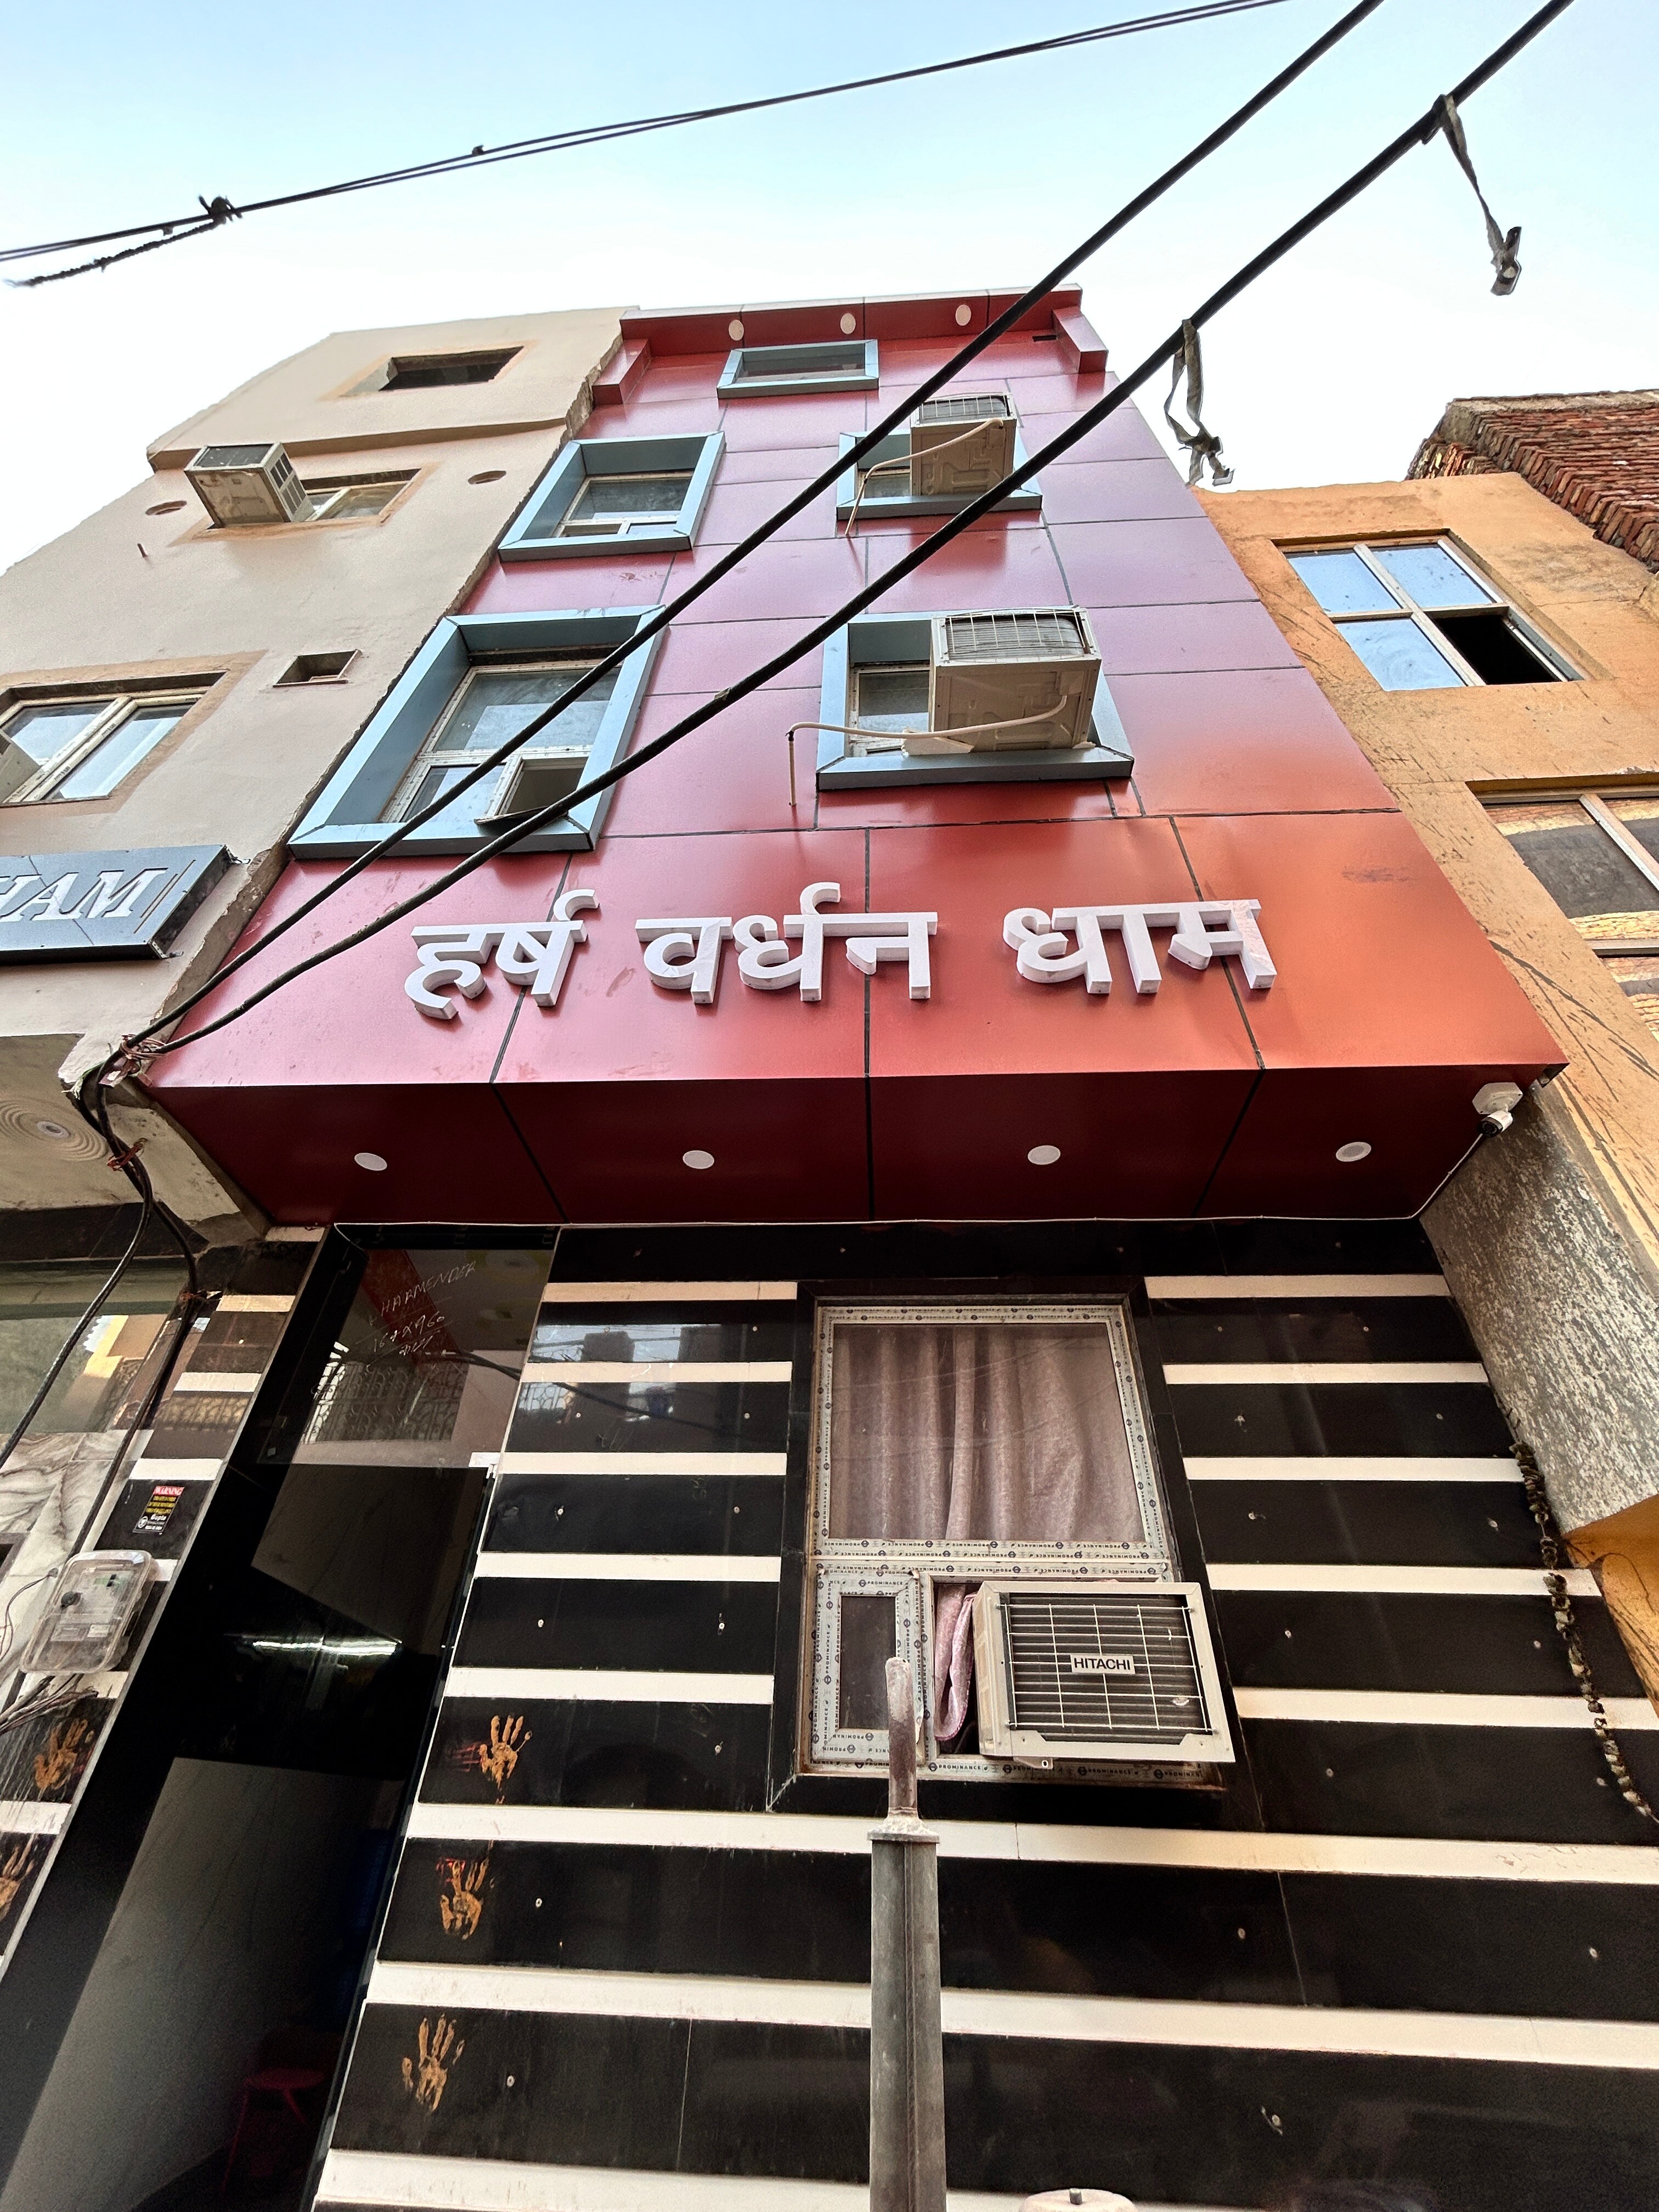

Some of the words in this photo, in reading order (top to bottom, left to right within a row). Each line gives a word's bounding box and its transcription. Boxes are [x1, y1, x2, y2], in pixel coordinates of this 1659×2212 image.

[404, 889, 599, 1019] हर्ष
[635, 882, 938, 1005] वर्धन
[1003, 899, 1277, 994] धाम
[1141, 1443, 1150, 1480] PROMINANCE
[1153, 1508, 1163, 1548] PROMINANCE
[1141, 1491, 1150, 1530] PROMINANCE
[1074, 1657, 1131, 1669] HITACHI
